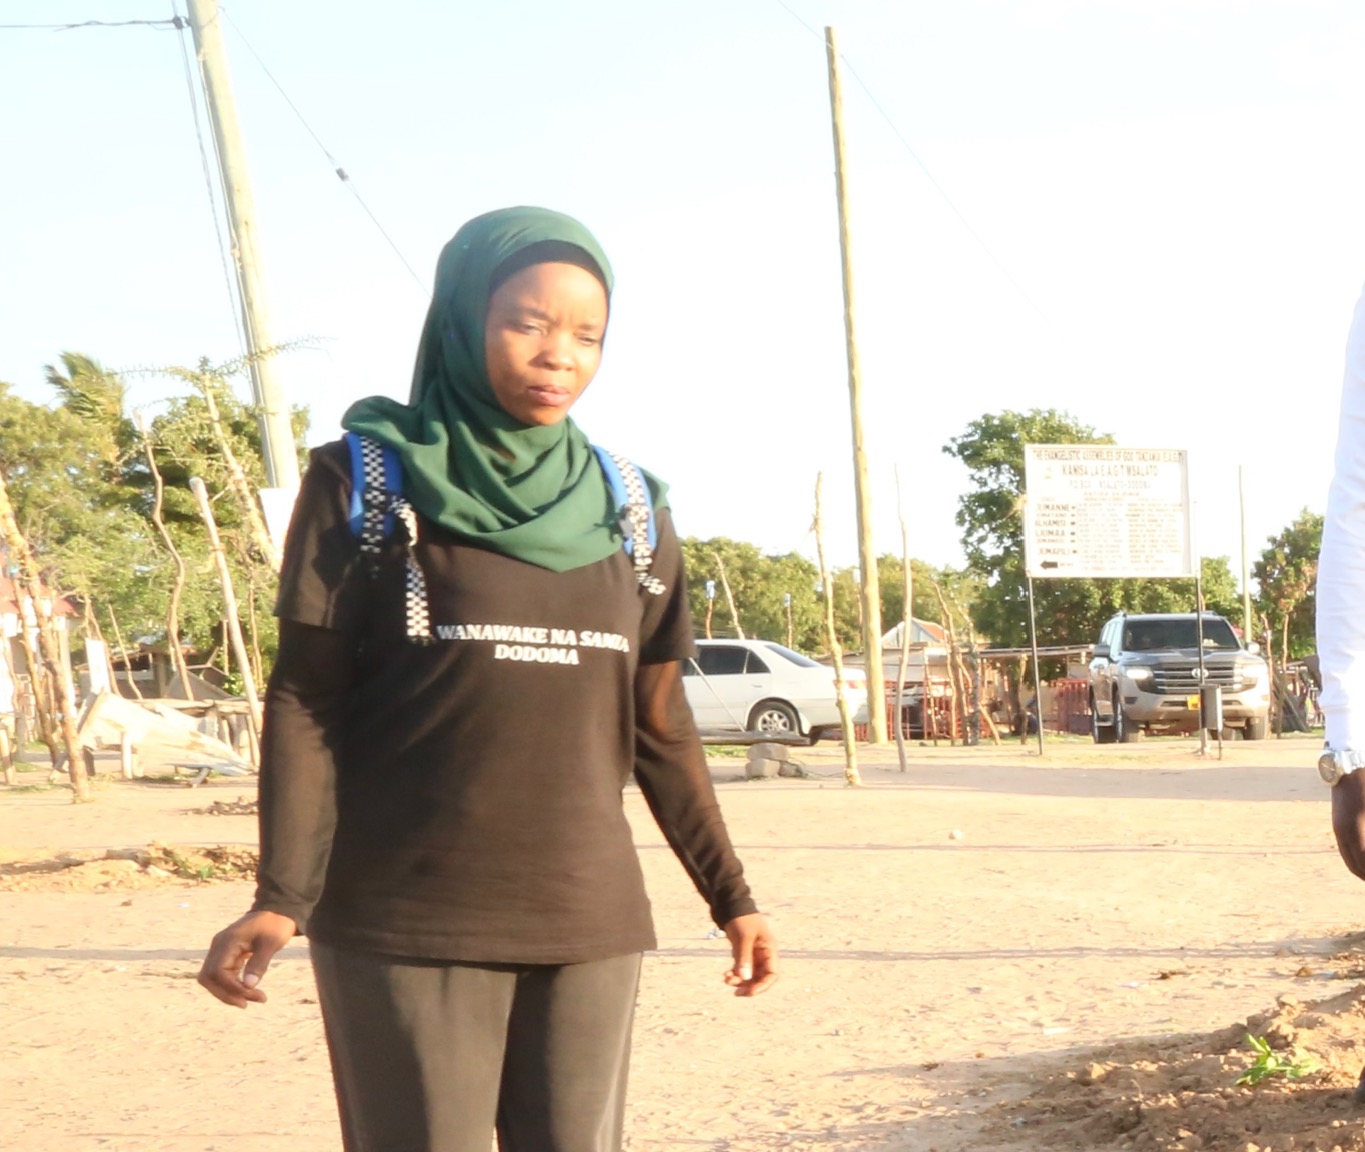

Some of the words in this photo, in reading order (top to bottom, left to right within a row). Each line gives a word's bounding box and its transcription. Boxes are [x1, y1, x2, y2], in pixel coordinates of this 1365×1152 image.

[436, 624, 548, 643] WANAWAKE
[550, 628, 578, 647] NA
[579, 630, 629, 653] SAMIA
[494, 644, 579, 665] DODOMA
